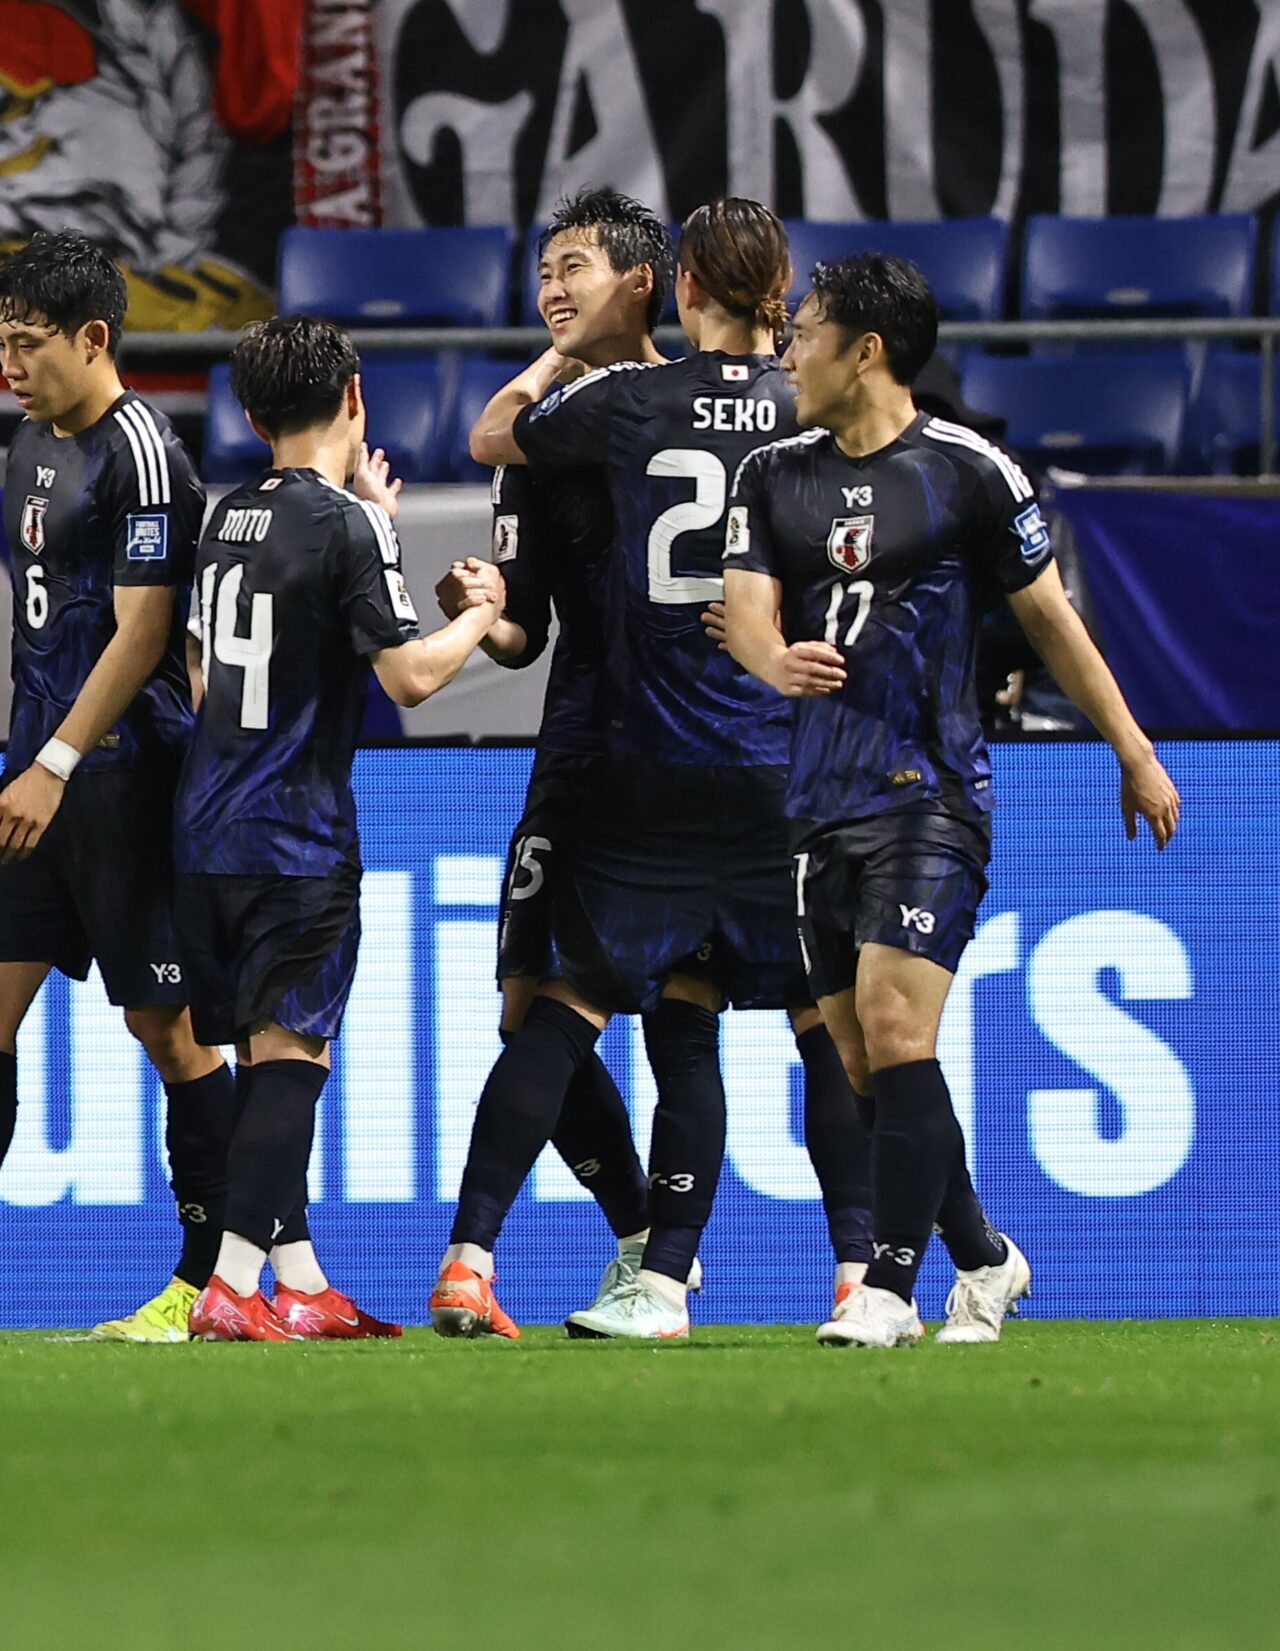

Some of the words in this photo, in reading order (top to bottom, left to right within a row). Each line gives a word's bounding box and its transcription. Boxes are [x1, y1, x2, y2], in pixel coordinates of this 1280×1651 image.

[306, 0, 369, 172] GRAN
[692, 397, 777, 432] SEKO
[841, 485, 874, 509] Y-3
[218, 509, 273, 542] MITO
[646, 448, 727, 605] 2
[25, 564, 49, 630] 6
[824, 580, 875, 646] 17
[200, 562, 273, 729] 14
[898, 904, 936, 935] Y-3
[149, 963, 182, 984] Y-3
[872, 1241, 916, 1266] Y-3
